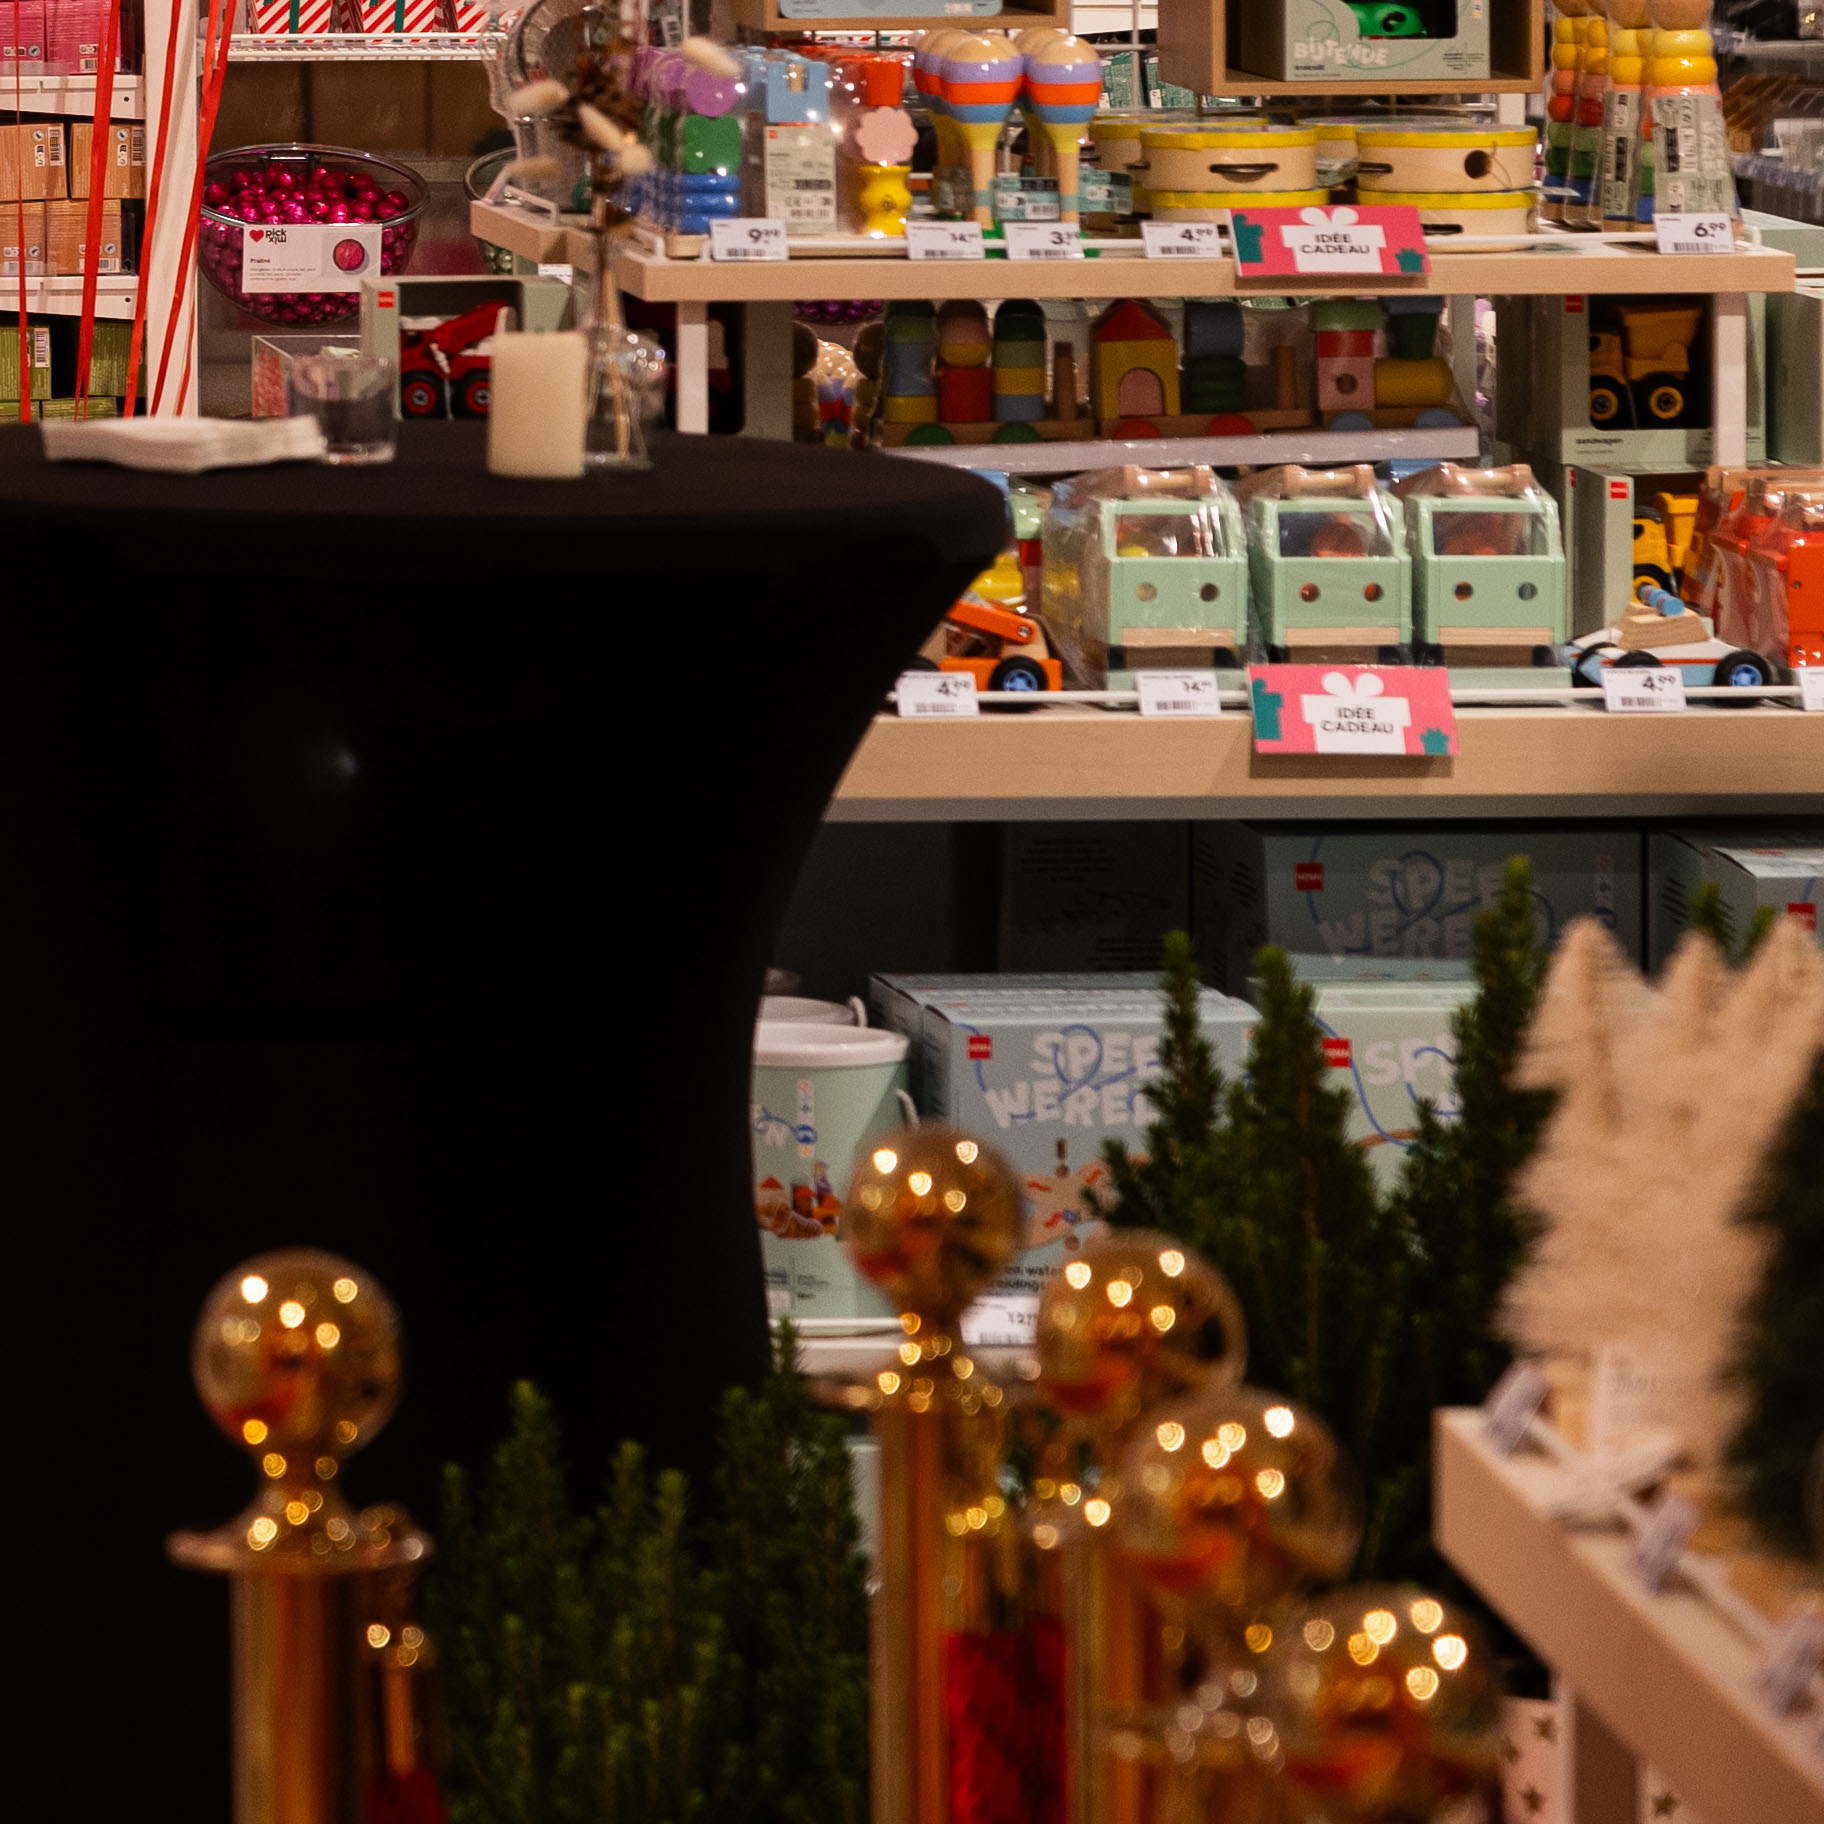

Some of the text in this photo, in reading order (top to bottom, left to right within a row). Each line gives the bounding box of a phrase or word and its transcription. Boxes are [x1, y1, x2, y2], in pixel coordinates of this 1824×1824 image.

[265, 228, 287, 238] pick
[1694, 221, 1727, 238] 6.99
[1314, 231, 1352, 244] IDÉE
[1300, 244, 1370, 255] CADEAU
[1336, 705, 1377, 721] IDÉE
[1320, 720, 1395, 735] CADEAU
[1367, 857, 1504, 908] SPEE
[1032, 1030, 1160, 1075] SPEE
